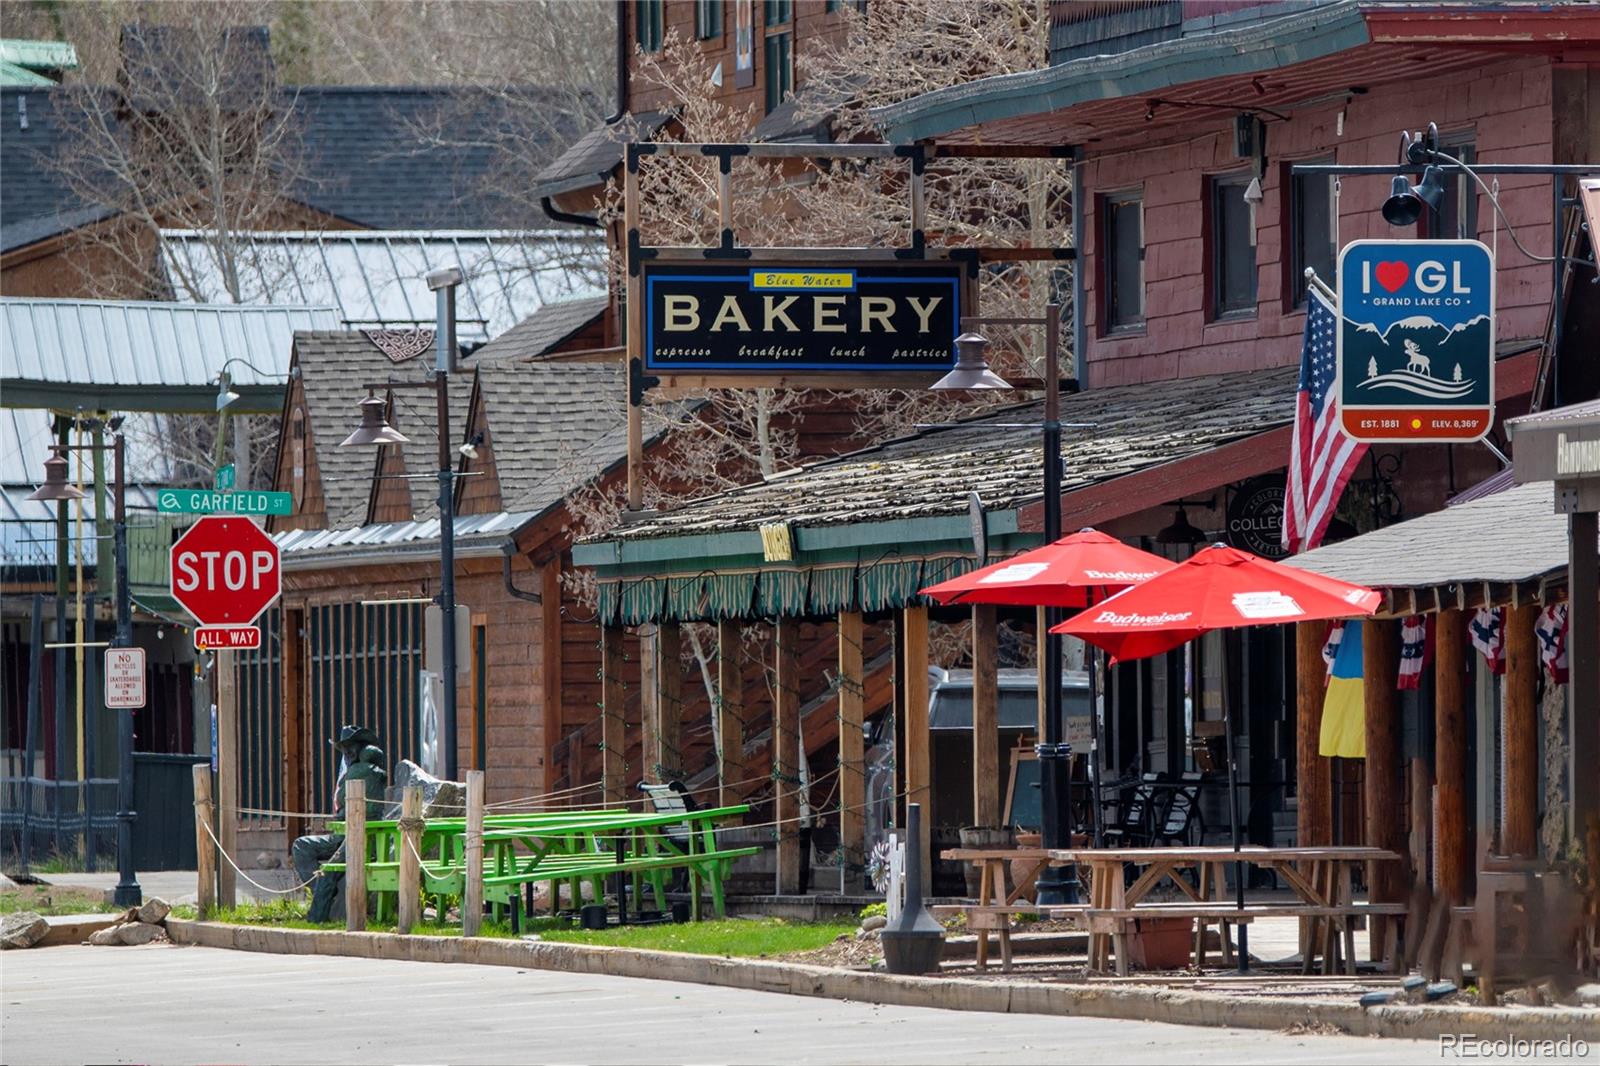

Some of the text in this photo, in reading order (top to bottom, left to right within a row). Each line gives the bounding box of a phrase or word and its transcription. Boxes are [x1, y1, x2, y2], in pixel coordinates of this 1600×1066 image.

[765, 274, 842, 287] Blue Water
[1362, 260, 1471, 294] I GL
[1372, 297, 1461, 307] GRAND LAKE CO
[663, 294, 943, 333] BAKERY
[655, 345, 948, 360] espresso breakfast lunch pastries
[1360, 419, 1400, 429] EST. 1881
[1431, 419, 1452, 429] ELEV.
[1557, 432, 1600, 474] HANDMAD
[190, 493, 268, 511] GARFIELD
[273, 498, 284, 508] ST
[1230, 515, 1284, 532] COLLEC
[176, 550, 274, 592] STOP
[1093, 610, 1193, 623] Budweiser
[200, 631, 255, 645] ALL WAY
[118, 654, 131, 663] NO
